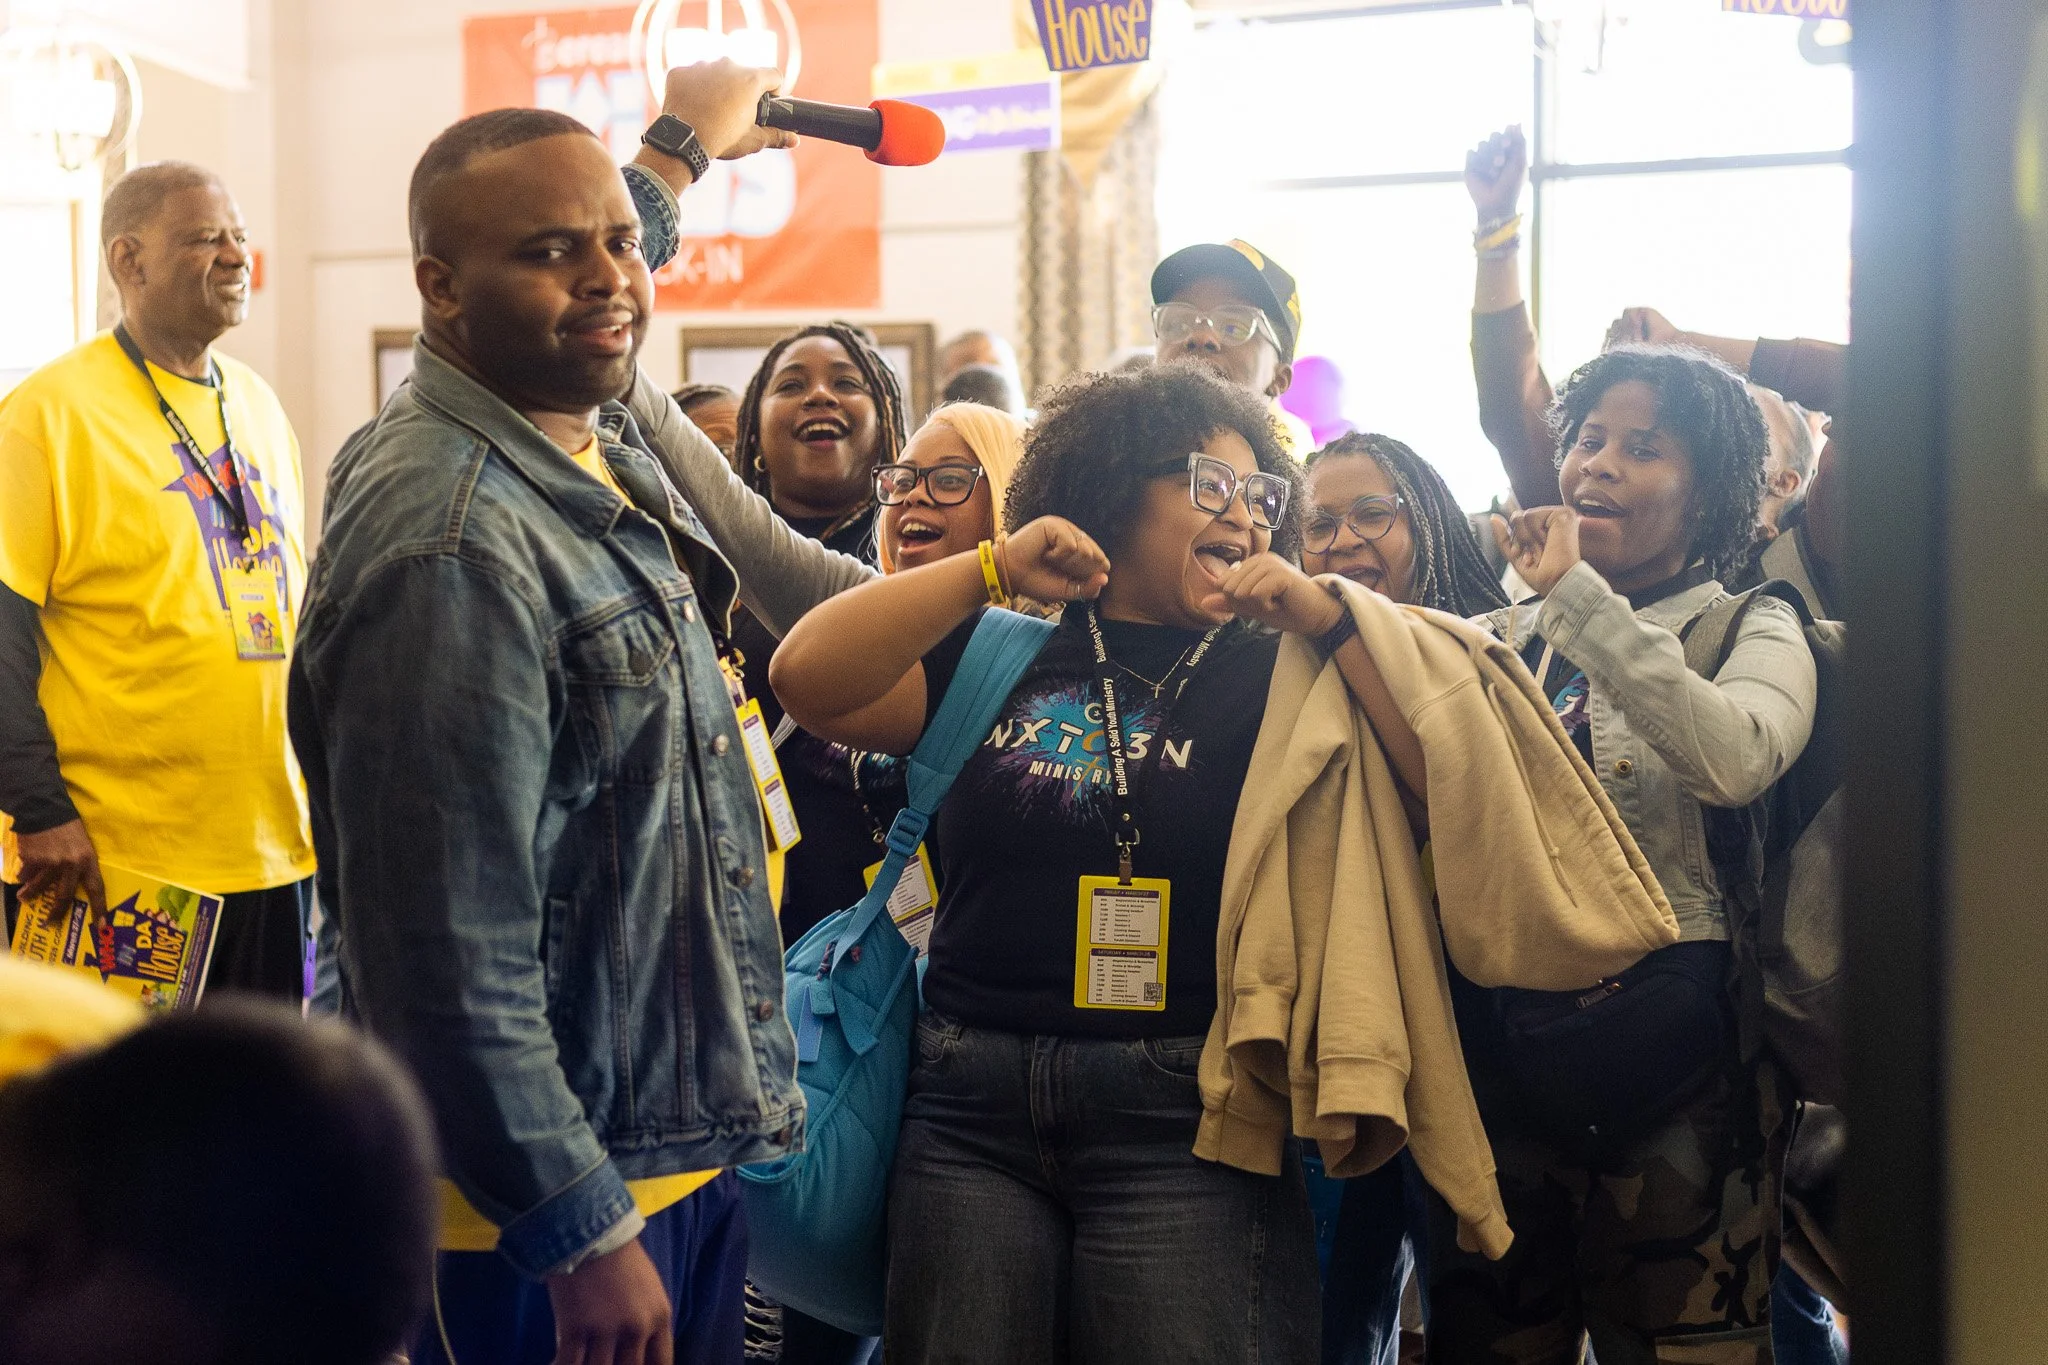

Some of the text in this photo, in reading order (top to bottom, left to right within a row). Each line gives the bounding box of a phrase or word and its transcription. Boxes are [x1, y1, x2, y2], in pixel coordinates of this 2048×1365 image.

[1090, 625, 1099, 634] A
[1094, 631, 1106, 663] Building
[1103, 677, 1128, 796] Building A Solid Youth Ministry
[99, 924, 115, 972] WHO
[136, 921, 152, 949] DA
